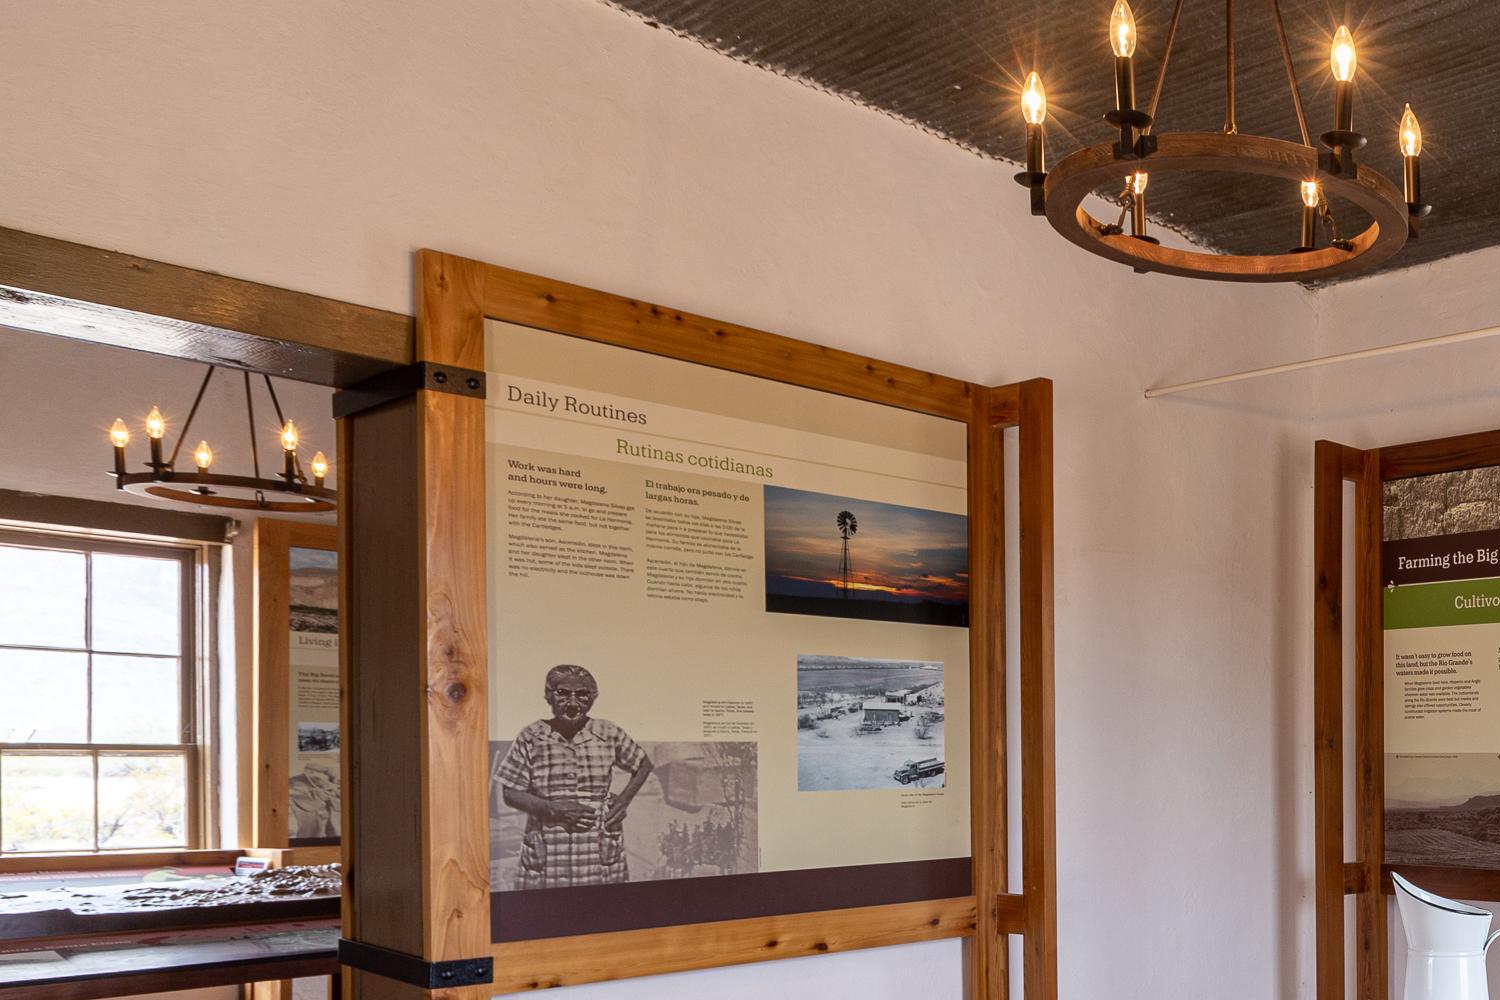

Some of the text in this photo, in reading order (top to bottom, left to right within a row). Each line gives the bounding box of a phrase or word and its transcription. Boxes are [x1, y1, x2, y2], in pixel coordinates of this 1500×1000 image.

[507, 385, 646, 425] Daily Routines
[507, 458, 580, 478] Work was hard
[616, 437, 772, 478] Rutinas cotidianas
[507, 472, 607, 495] and hours were long.
[1398, 551, 1450, 571] Farming
[1452, 549, 1473, 565] the
[1476, 546, 1498, 566] Big
[298, 636, 333, 648] Living
